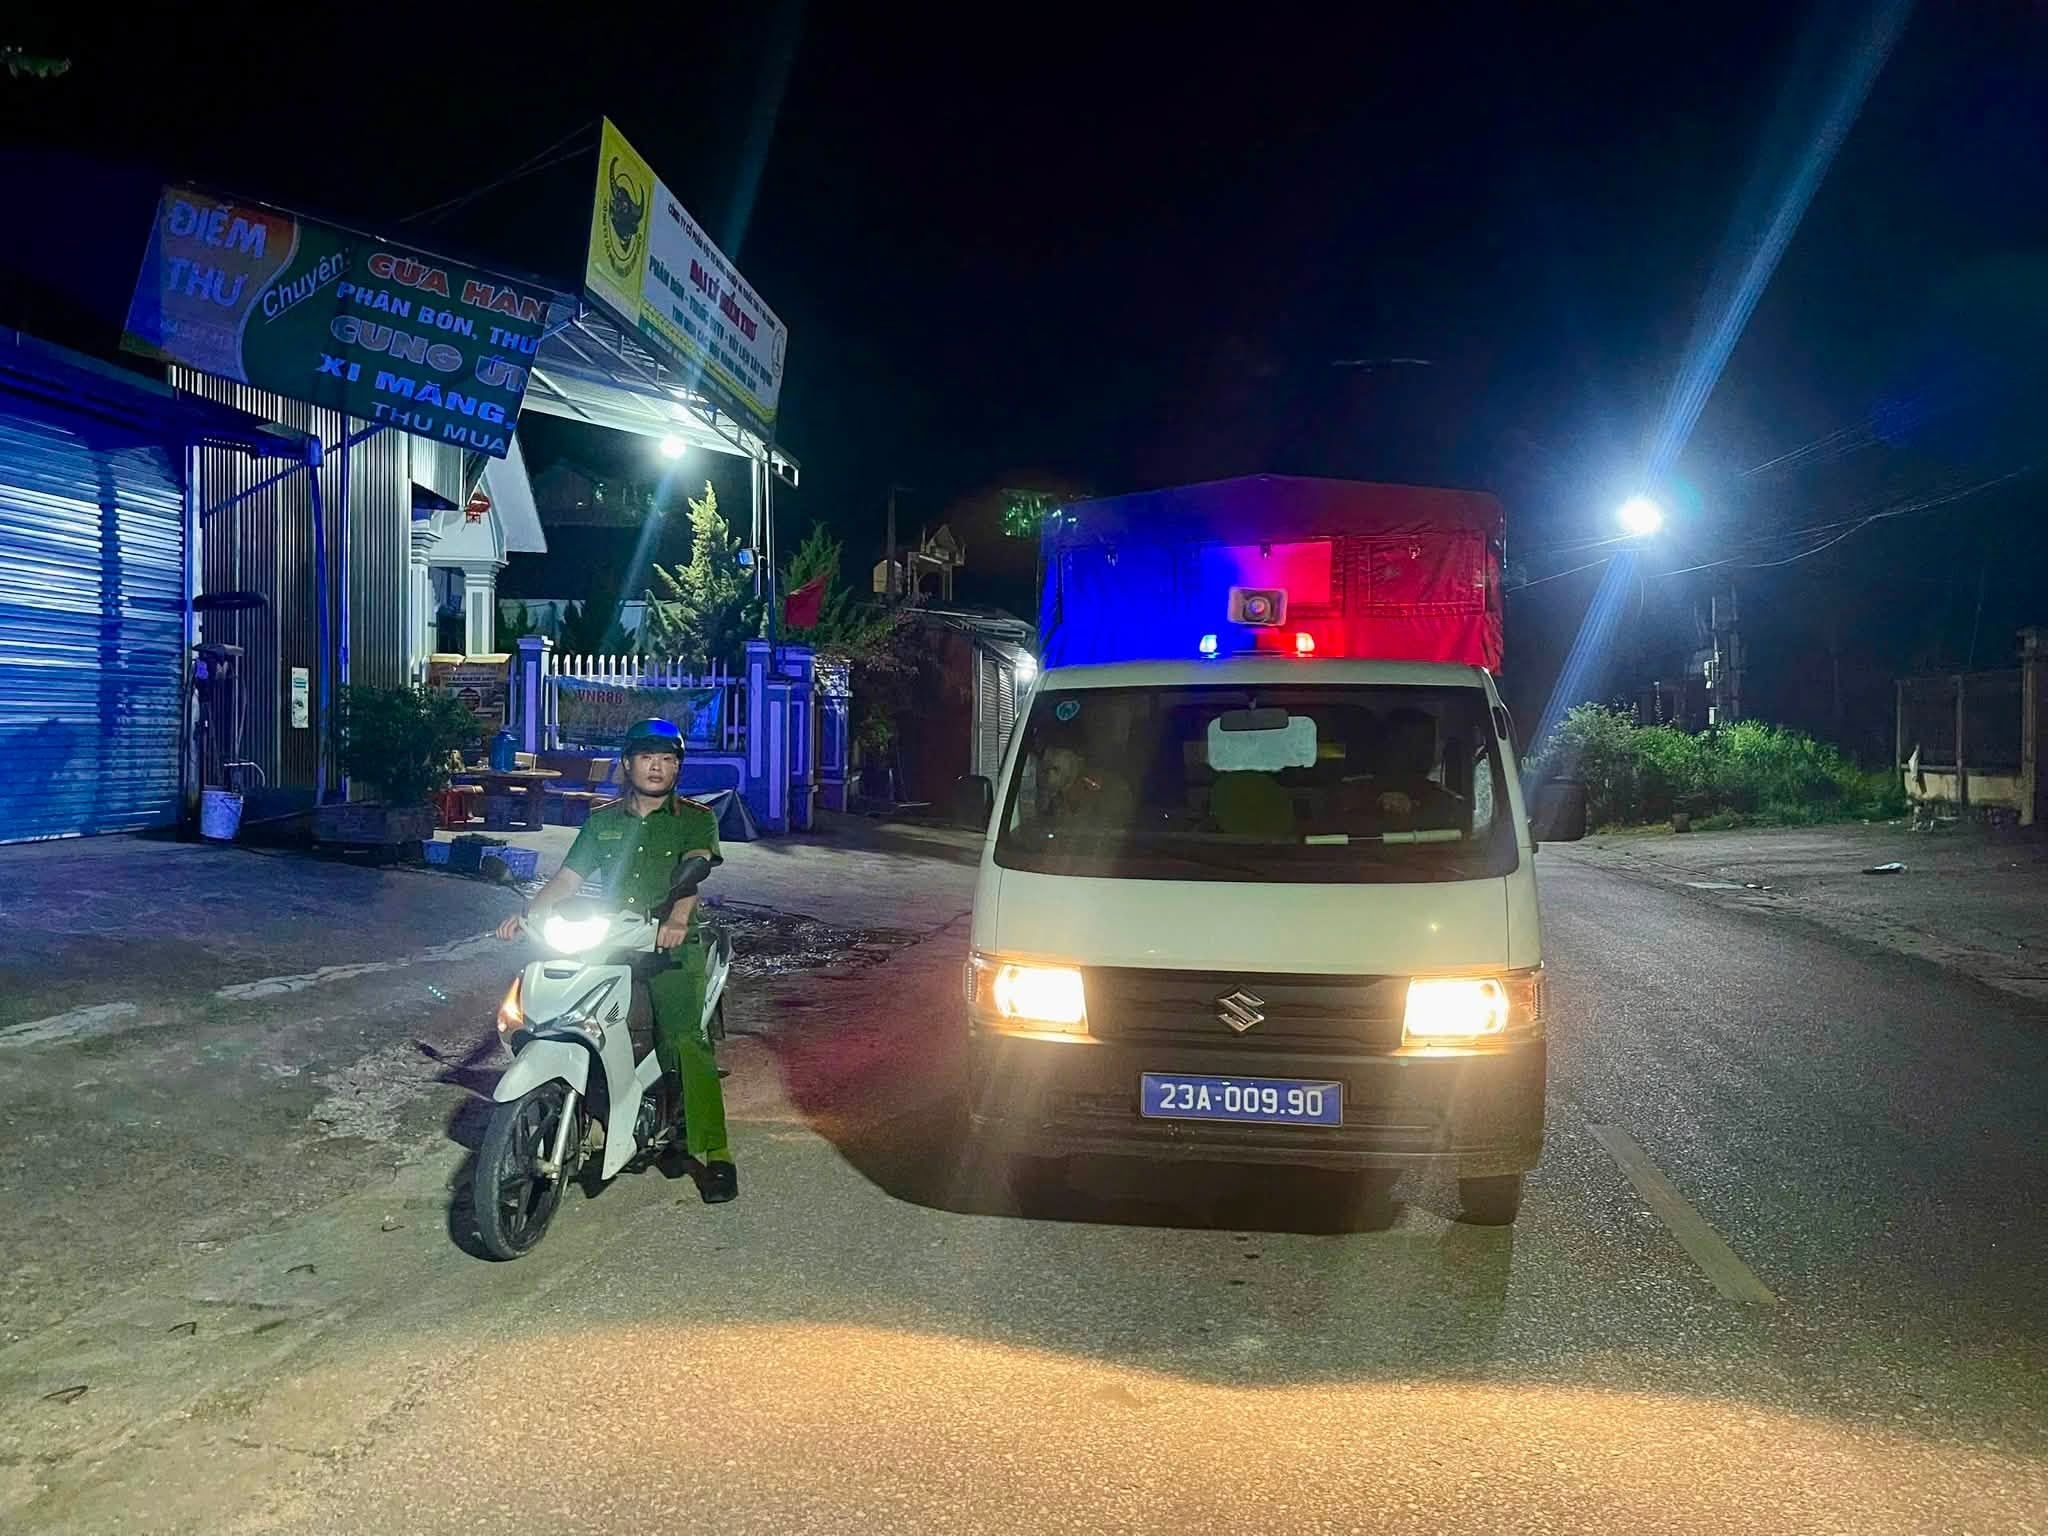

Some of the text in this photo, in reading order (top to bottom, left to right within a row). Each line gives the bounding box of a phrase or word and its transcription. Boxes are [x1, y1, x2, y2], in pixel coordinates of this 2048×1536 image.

[168, 199, 267, 258] ĐIỂM
[169, 256, 248, 306] THU
[367, 253, 450, 298] CỬA
[336, 281, 411, 318] PHÂN
[417, 305, 479, 341] BÓN,
[316, 351, 361, 383] XI
[330, 314, 464, 373] CUNG
[371, 401, 507, 452] THU MUA
[1159, 1082, 1323, 1117] 23A-009.90
